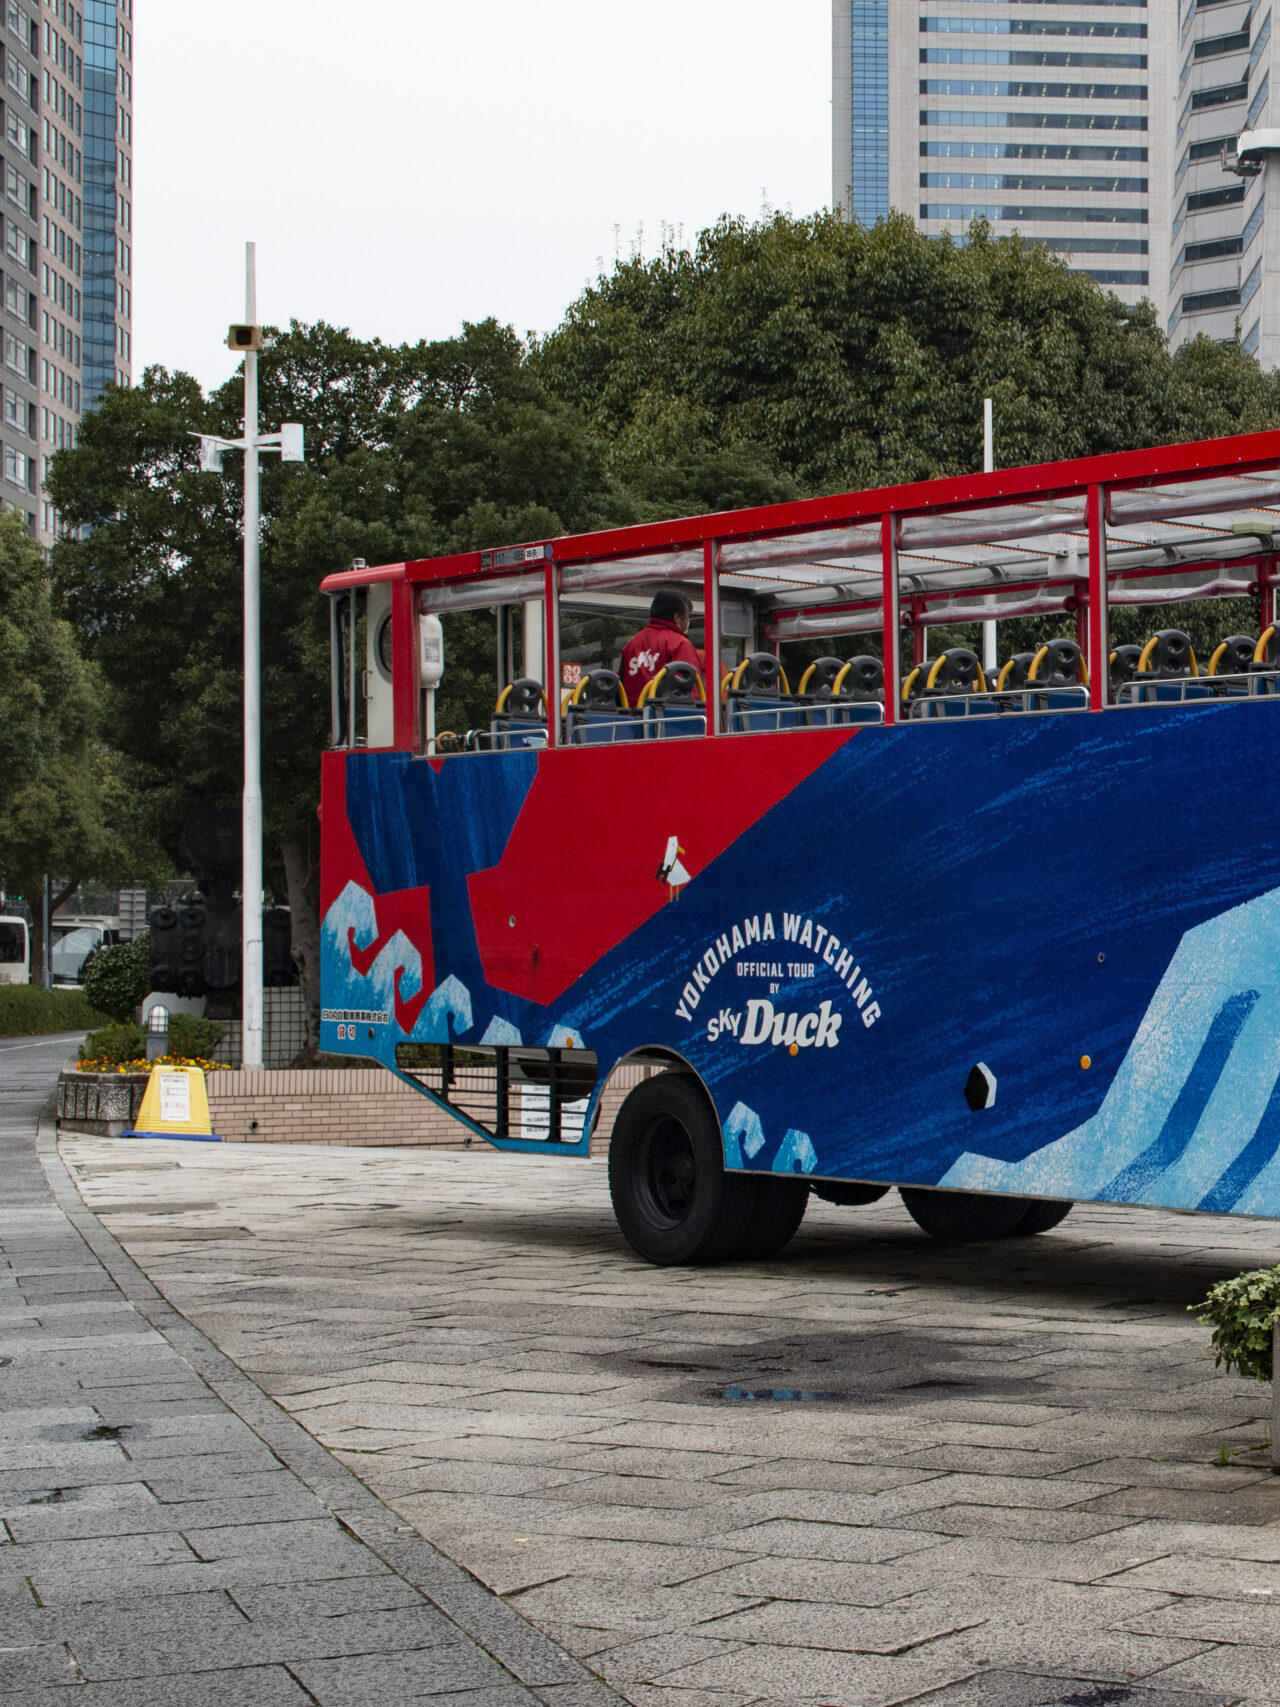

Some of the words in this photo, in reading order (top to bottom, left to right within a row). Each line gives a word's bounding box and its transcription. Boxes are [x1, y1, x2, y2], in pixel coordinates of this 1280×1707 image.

[628, 648, 660, 676] SKY
[675, 912, 776, 1023] YOKOHAMA
[782, 912, 882, 1029] WATCHING
[736, 962, 784, 977] OFFICIAL
[787, 963, 815, 978] TOUR
[769, 983, 780, 994] BY
[707, 1007, 742, 1042] SKY
[739, 999, 843, 1048] Duck
